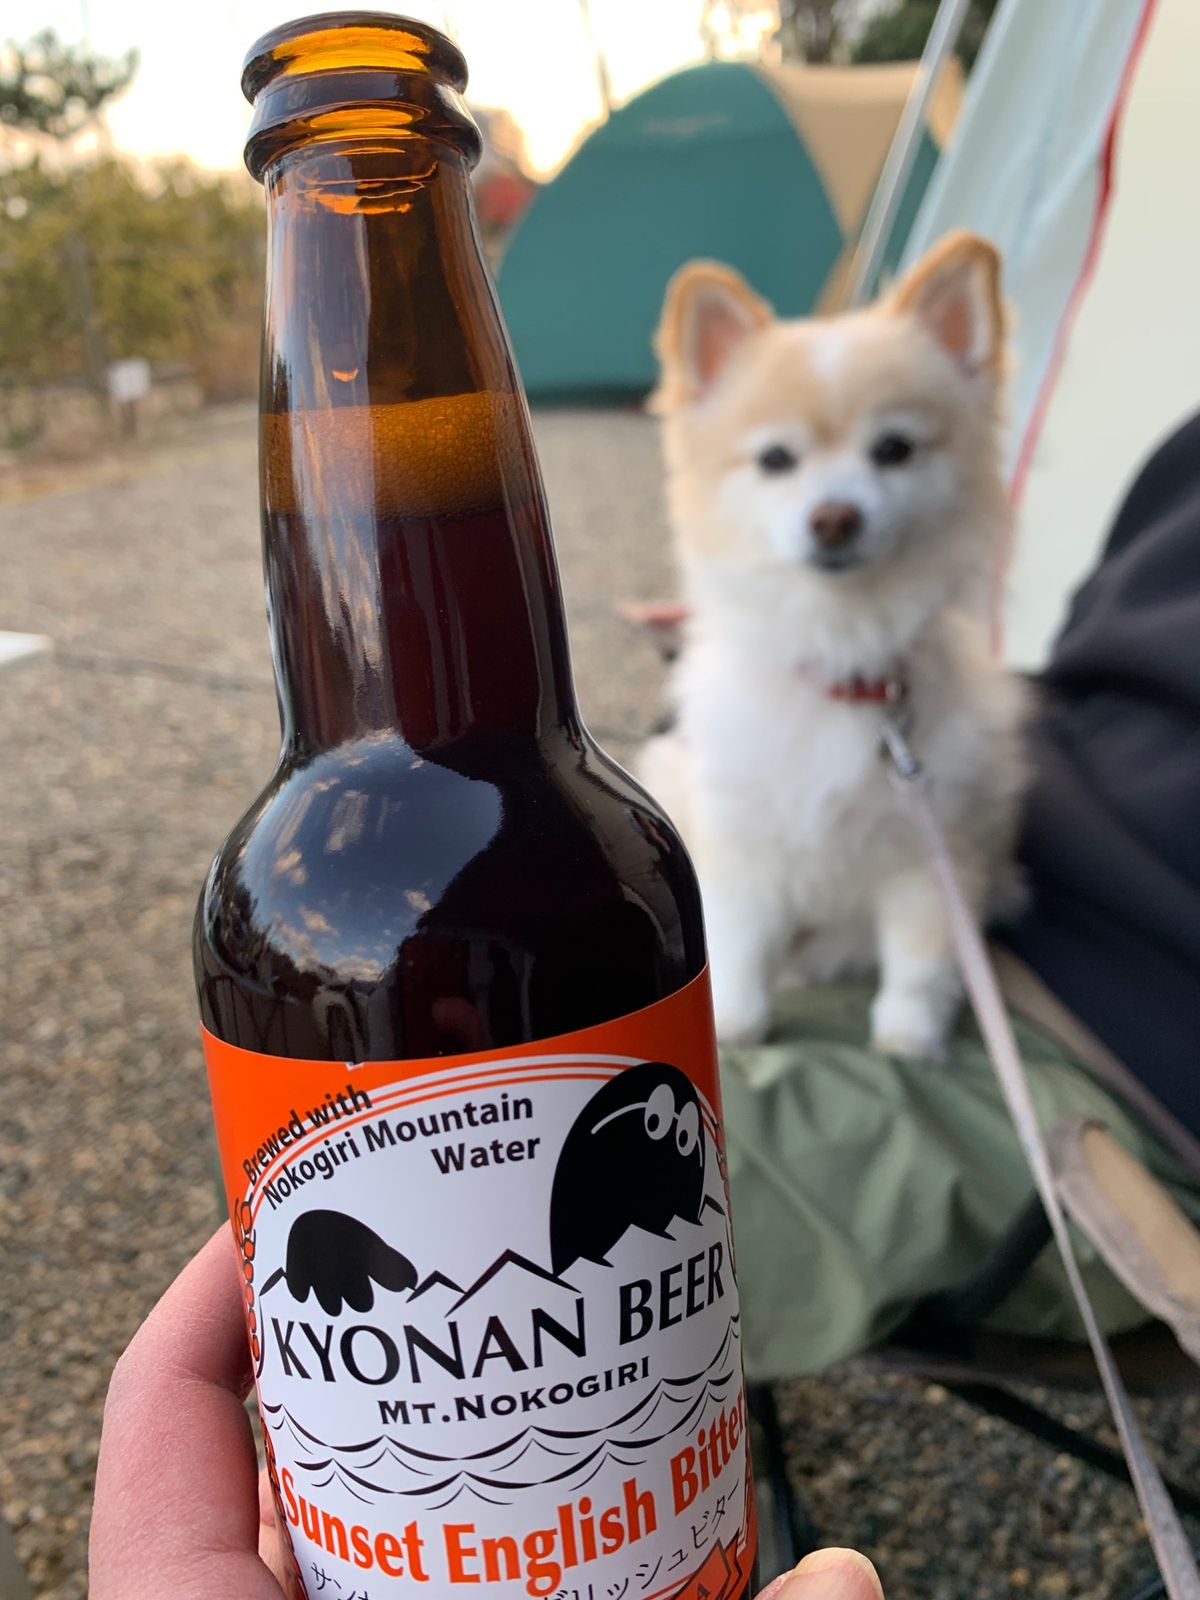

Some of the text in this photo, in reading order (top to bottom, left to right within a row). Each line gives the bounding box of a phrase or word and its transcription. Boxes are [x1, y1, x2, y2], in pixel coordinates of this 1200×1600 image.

[242, 1085, 373, 1186] Brewed with
[262, 1093, 534, 1210] Nokogiri Mountain
[431, 1136, 541, 1175] Water
[271, 1241, 725, 1386] KYONAN BEER
[281, 1389, 743, 1598] Sunset English Bitter
